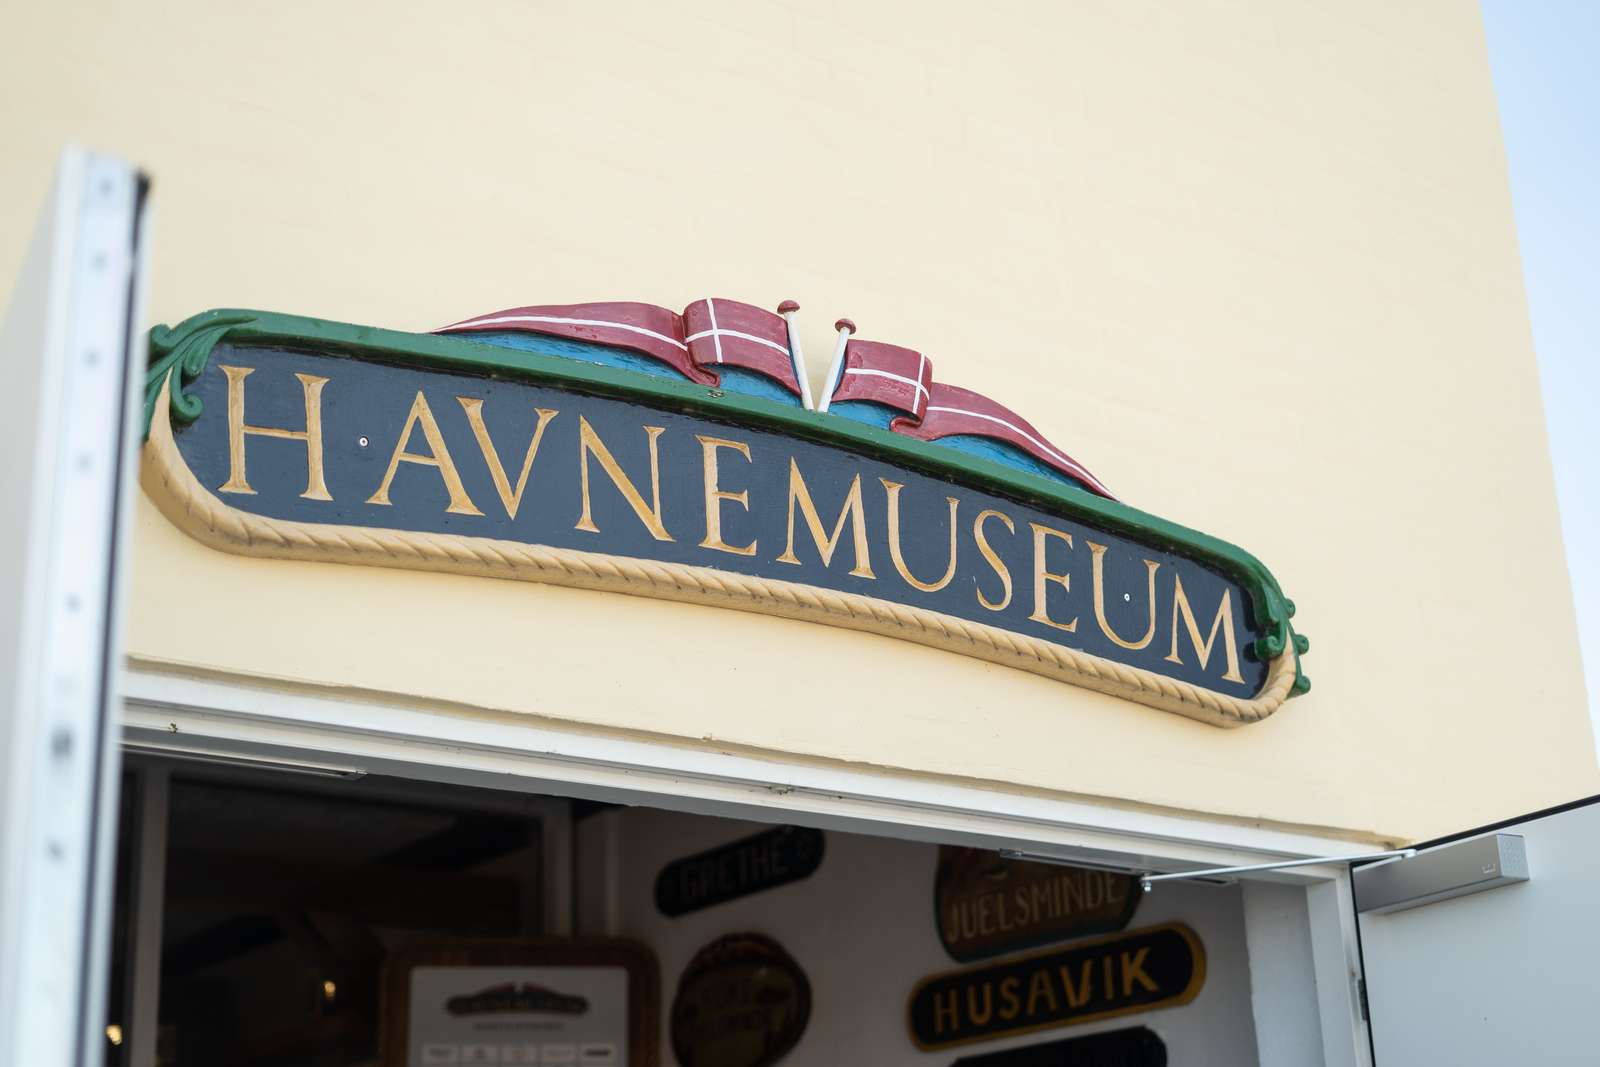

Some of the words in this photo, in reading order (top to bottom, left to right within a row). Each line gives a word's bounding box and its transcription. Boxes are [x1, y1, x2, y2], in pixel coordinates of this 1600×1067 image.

[217, 364, 1246, 686] HAVNEMUSEUM
[946, 870, 1124, 944] JUELSMINDE
[932, 946, 1161, 1035] HUSAVIK
